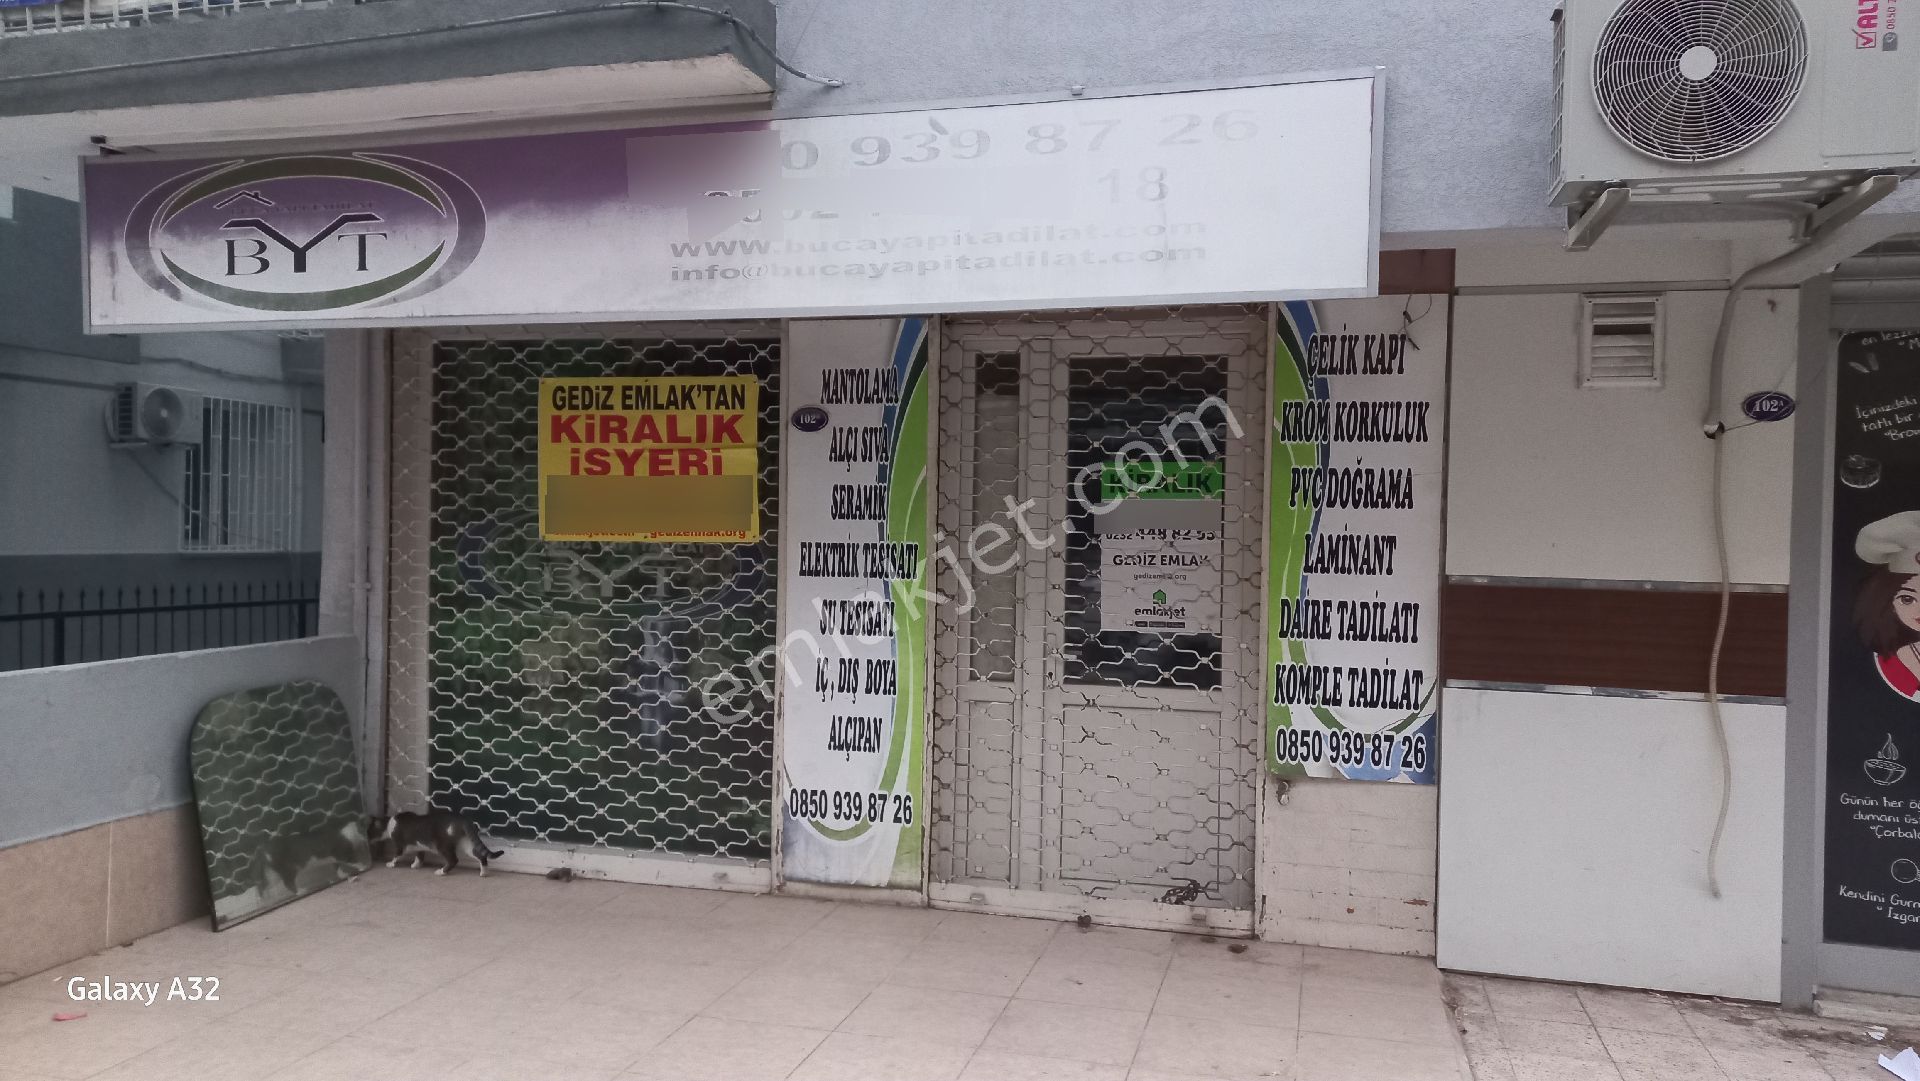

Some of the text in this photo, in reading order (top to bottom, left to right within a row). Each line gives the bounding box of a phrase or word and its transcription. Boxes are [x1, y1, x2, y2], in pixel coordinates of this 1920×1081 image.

[850, 128, 991, 166] 939
[1025, 119, 1121, 155] 87
[1158, 110, 1259, 146] 26
[220, 211, 387, 277] BYT
[670, 220, 1207, 257] www.bucayapitadilat.com
[671, 246, 1207, 281] info@bucayapitadilat.com
[1308, 323, 1406, 387] ÇELİK KAPI
[621, 384, 746, 411] EMLAK'TAN
[821, 366, 899, 404] MANTOLAMA
[1280, 401, 1430, 443] KROM KORKULUK
[829, 426, 889, 472] ALÇI SIVA
[831, 475, 887, 520] SERAMİK
[1288, 456, 1414, 510] PVC DOĞRAMA
[799, 532, 919, 580] ELEKTRİK TESİSATI
[1303, 523, 1397, 576] LAMİNANT
[819, 599, 837, 636] SU
[1279, 588, 1420, 643] DAİRE TADİLATI
[838, 657, 860, 704] DIŞ
[865, 658, 897, 696] BOYA
[1274, 658, 1424, 710] KOMPLE TADİLAT
[827, 714, 883, 762] ALÇIPAN
[1276, 729, 1426, 769] 0850 939 87 26
[789, 788, 913, 824] 0850 939 87 26
[1840, 792, 1879, 806] Günün
[1882, 796, 1905, 807] her
[1904, 814, 1920, 824] üs
[1839, 884, 1885, 903] Kendini
